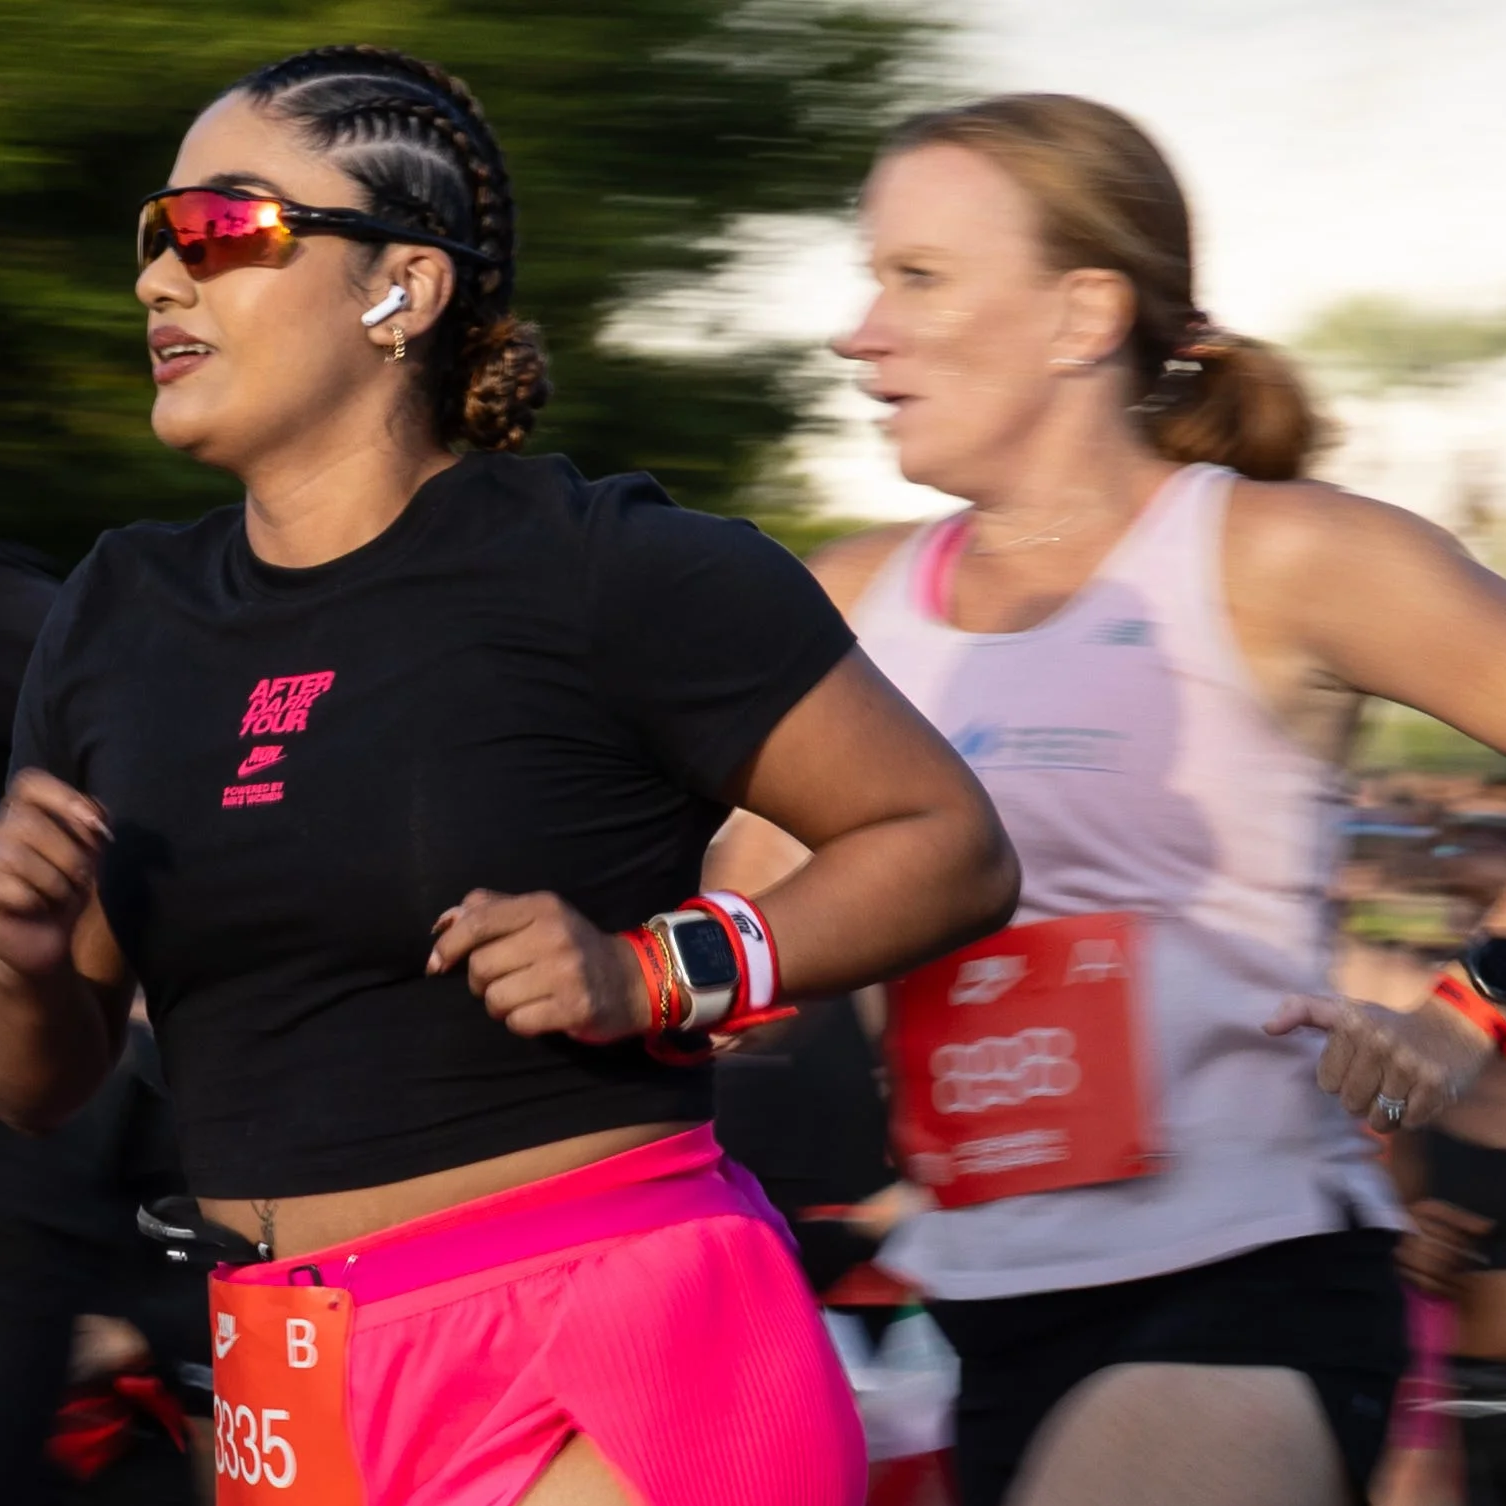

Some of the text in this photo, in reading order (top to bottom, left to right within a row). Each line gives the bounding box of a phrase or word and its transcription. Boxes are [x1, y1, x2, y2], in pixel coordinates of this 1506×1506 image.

[248, 670, 335, 701] AFTER
[242, 692, 320, 723] DARK
[239, 709, 308, 738] TOUR
[285, 1317, 319, 1369] B
